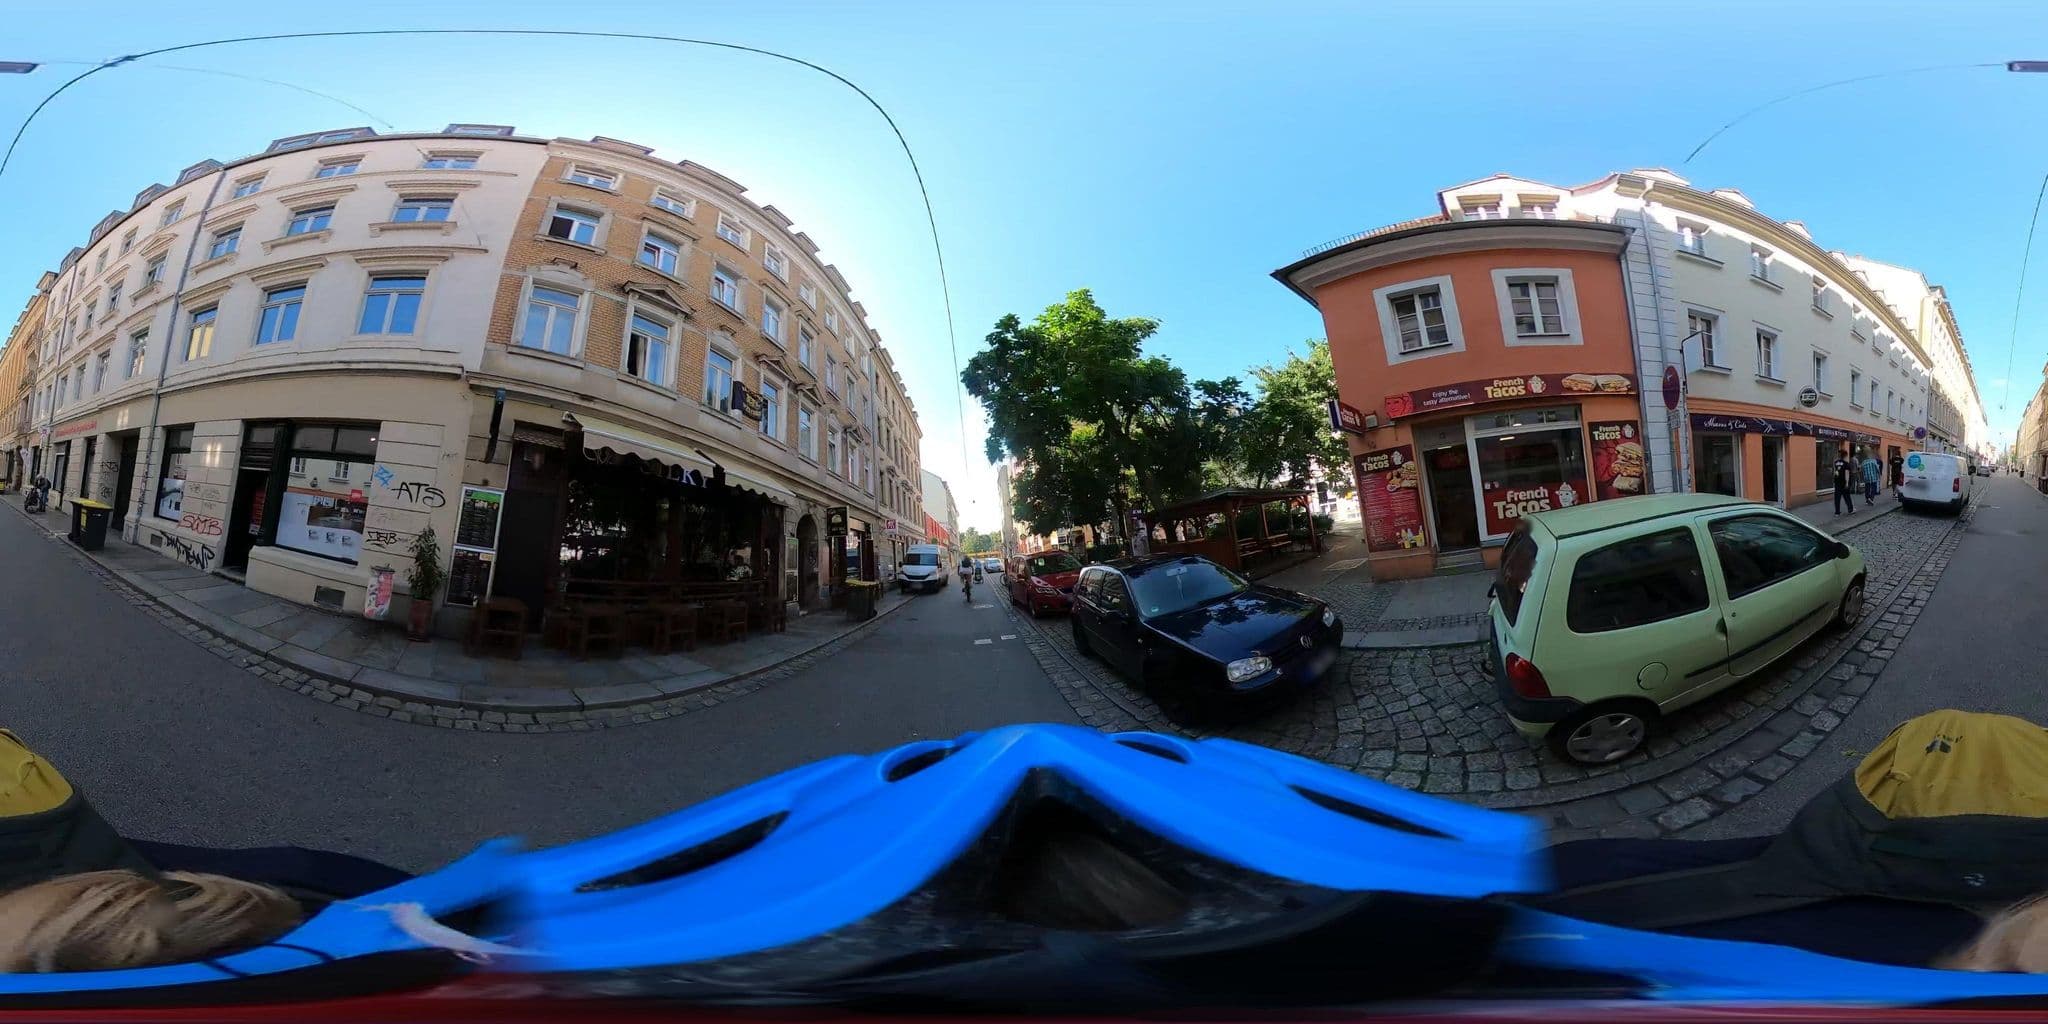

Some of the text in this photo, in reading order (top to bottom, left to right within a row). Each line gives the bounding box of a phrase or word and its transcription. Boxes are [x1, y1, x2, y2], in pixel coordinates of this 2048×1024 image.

[1493, 377, 1524, 388] French
[1484, 384, 1526, 398] Tacos
[1438, 393, 1471, 404] alternative!
[1593, 430, 1621, 440] Tacos
[1367, 453, 1388, 462] French
[1361, 460, 1390, 472] Tacos
[391, 481, 446, 508] ATS
[1506, 486, 1549, 502] French
[1493, 499, 1551, 519] Tacos
